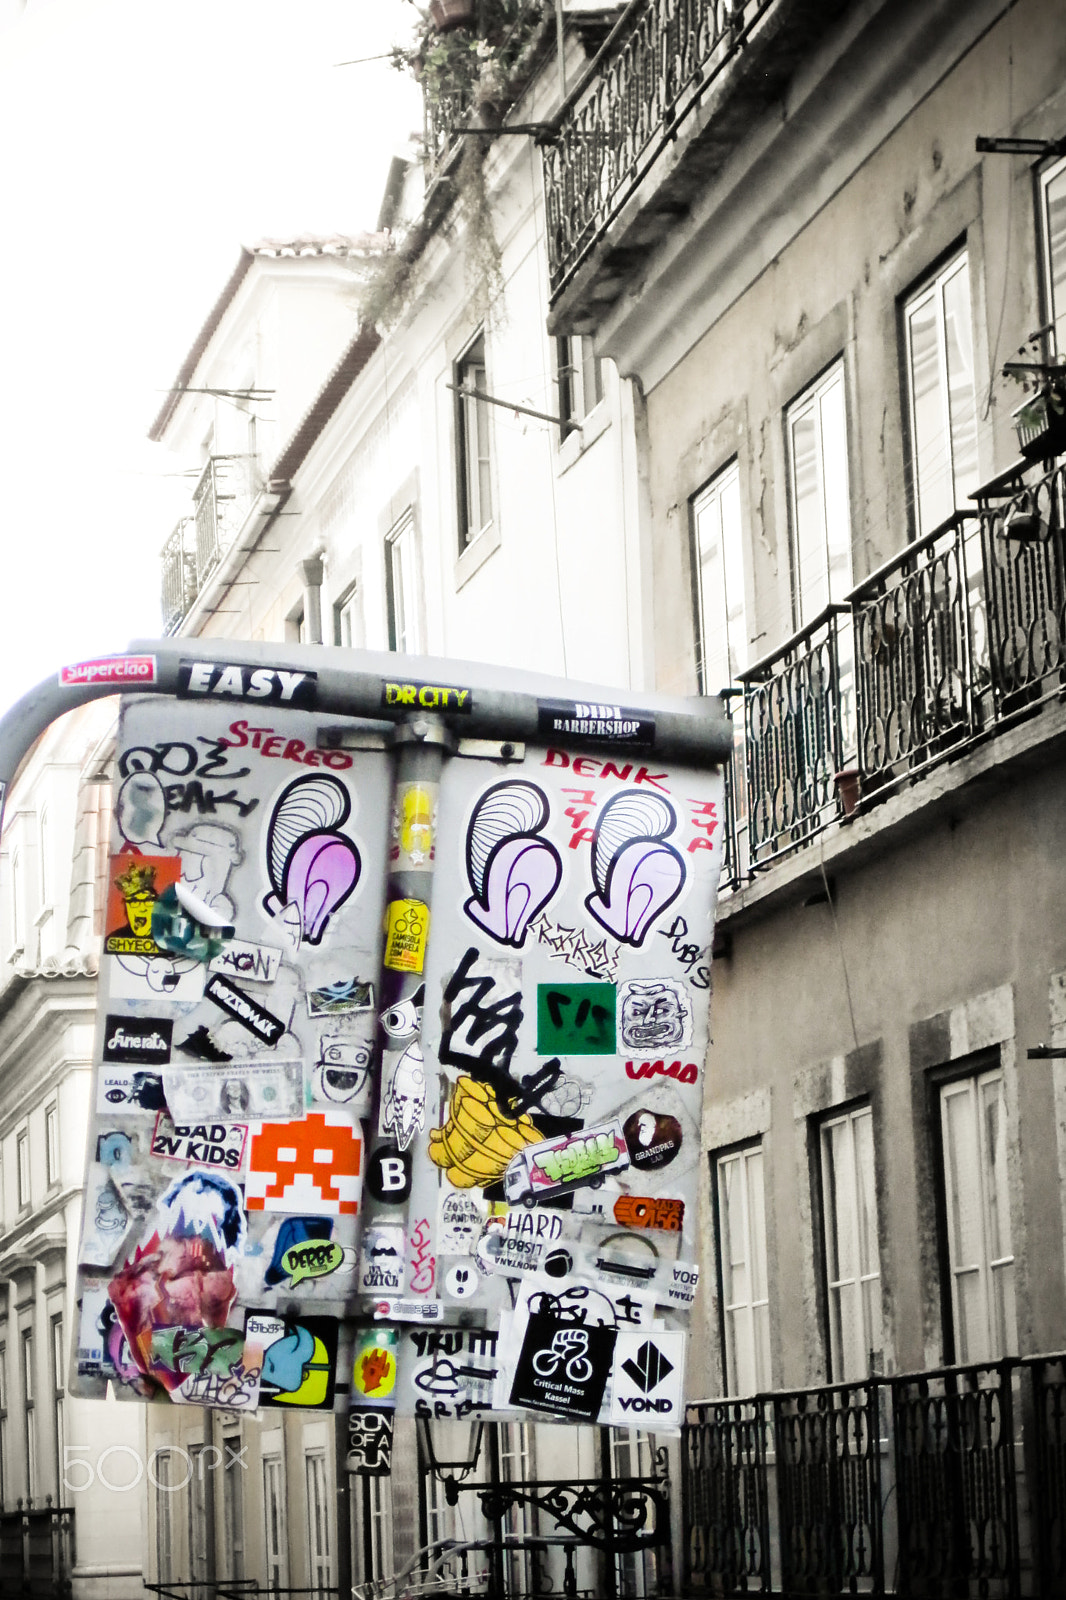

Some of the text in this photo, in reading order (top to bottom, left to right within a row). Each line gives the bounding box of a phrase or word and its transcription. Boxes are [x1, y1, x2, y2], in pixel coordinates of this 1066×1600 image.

[188, 663, 306, 700] EASY
[575, 704, 622, 720] DIDI
[553, 719, 640, 735] BARBERSHOP
[217, 719, 353, 770] STEREO
[540, 747, 671, 794] DENK
[185, 1141, 240, 1168] KIDS
[379, 1157, 407, 1192] B
[508, 1212, 563, 1241] HARD
[495, 1257, 537, 1272] MONTANA
[533, 1378, 585, 1396] Critical Mass
[544, 1392, 571, 1404] Kassel
[618, 1397, 673, 1413] VOND
[349, 1412, 394, 1433] SON
[351, 1433, 390, 1448] OF A
